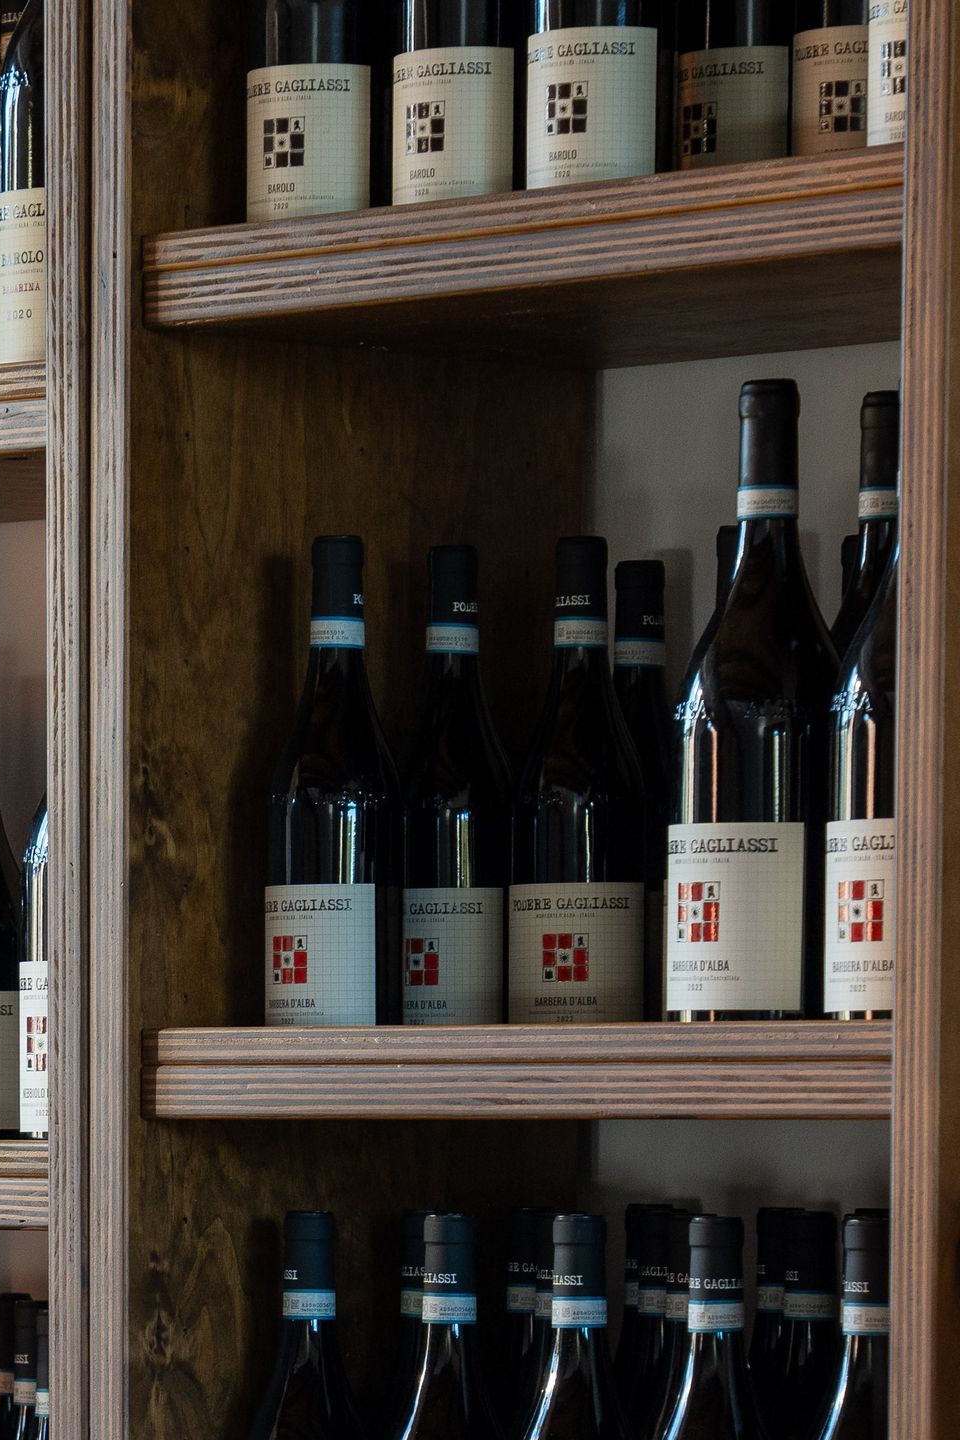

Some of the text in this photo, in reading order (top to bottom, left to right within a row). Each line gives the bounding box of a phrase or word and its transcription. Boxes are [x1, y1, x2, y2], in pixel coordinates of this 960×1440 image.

[557, 41, 637, 57] GAGLIASSI
[416, 62, 493, 77] GAGLIASSI
[692, 61, 765, 78] GAGLIASSI
[275, 77, 351, 95] GAGLIASSI
[548, 149, 577, 162] BAROLO
[409, 168, 435, 180] BAROLO
[267, 182, 296, 194] BAROLO
[1, 250, 44, 267] BAROLO
[6, 309, 33, 320] 2020
[690, 837, 779, 853] GAGLIASSI
[281, 898, 353, 912] GAGLIASSI
[409, 902, 484, 915] GAGLIASSI
[513, 896, 631, 912] PODERE GAGLIASSI
[672, 959, 730, 972] BARBERA D'ALBA
[832, 959, 895, 973] BARBERA D'ALBA
[849, 984, 867, 992] 2022
[290, 998, 316, 1009] D'ALBA
[421, 1000, 447, 1010] D'ALBA
[534, 996, 598, 1007] BARBERA D'ALBA
[556, 1015, 574, 1023] 2022
